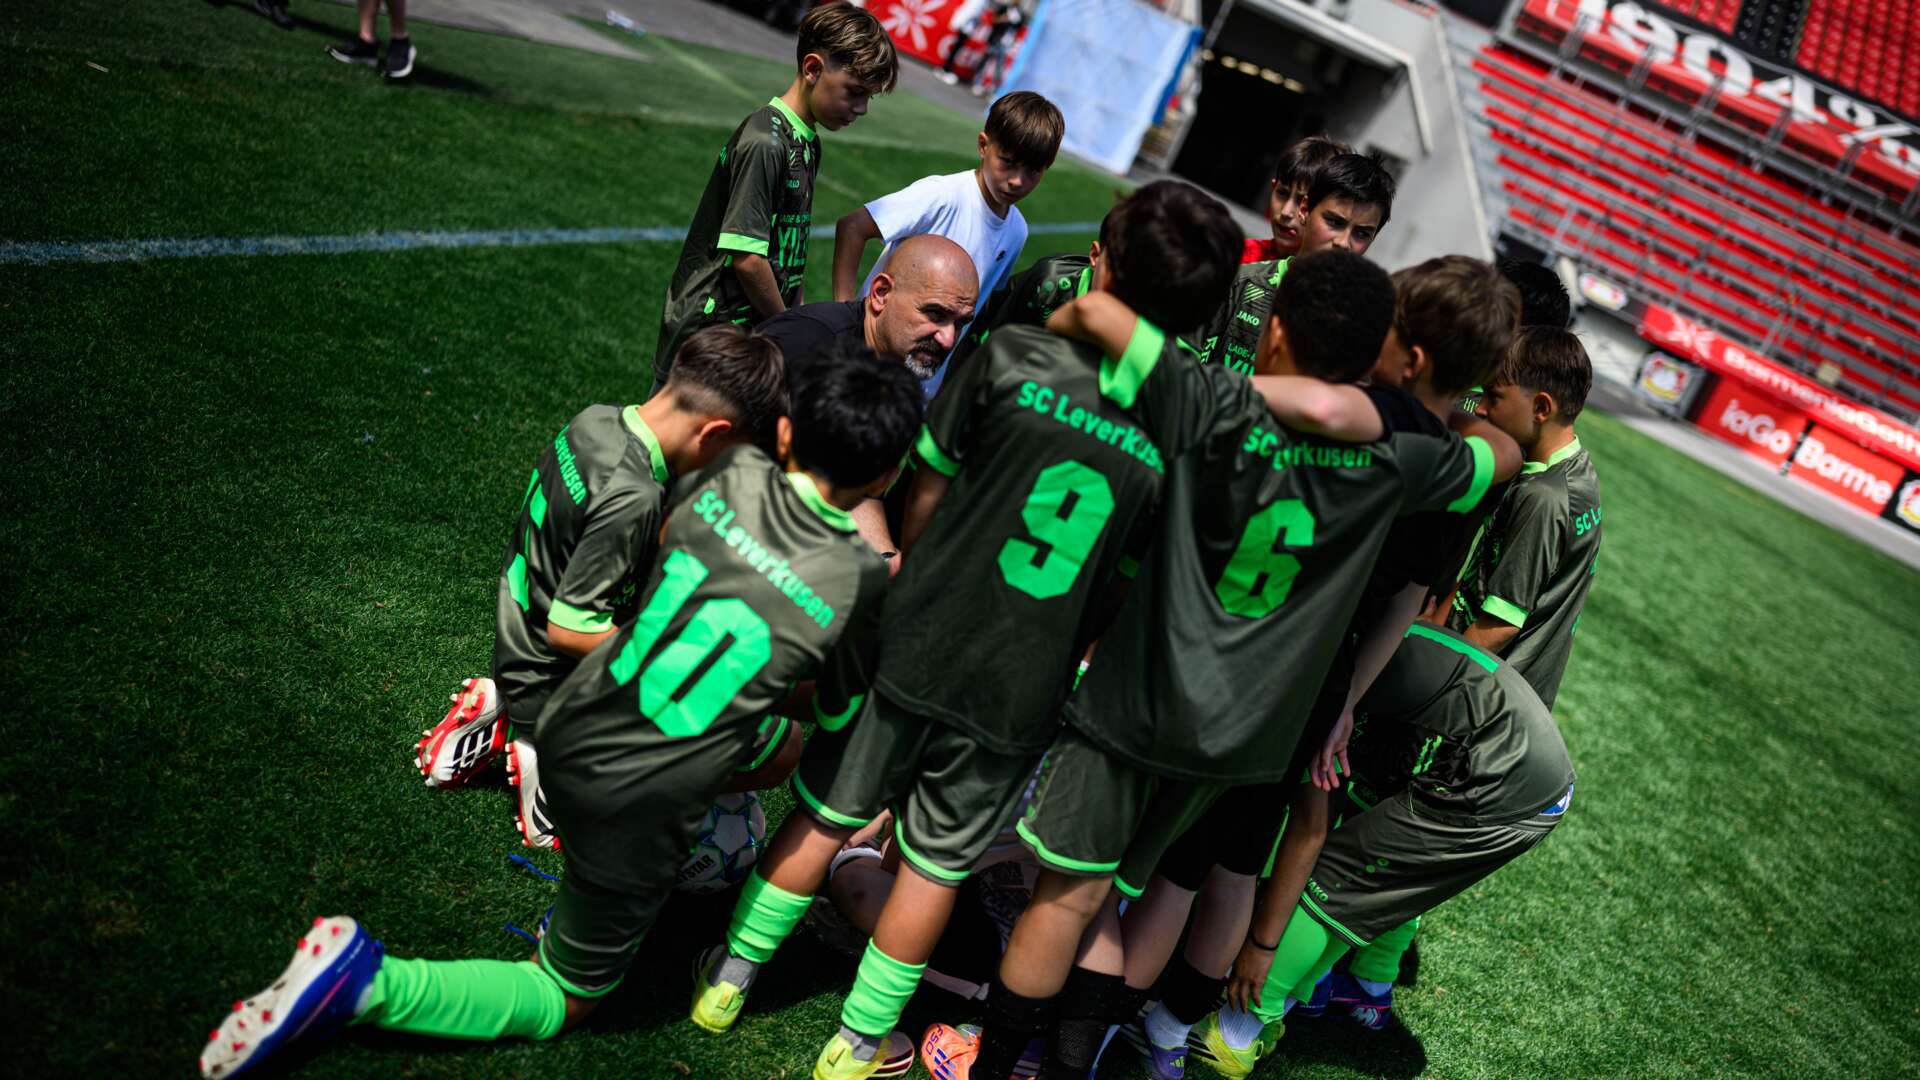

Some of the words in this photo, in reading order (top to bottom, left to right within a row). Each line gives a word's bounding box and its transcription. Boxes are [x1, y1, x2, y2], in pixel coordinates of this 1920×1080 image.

[1236, 310, 1260, 326] JAKO
[1016, 380, 1055, 414] SC
[1243, 425, 1279, 457] SC
[1794, 436, 1894, 506] Barme
[692, 489, 726, 524] SC
[712, 509, 835, 629] Leverkusen
[998, 460, 1115, 600] 9
[1214, 499, 1315, 619] 6
[1575, 512, 1592, 536] SC
[609, 549, 772, 737] 10
